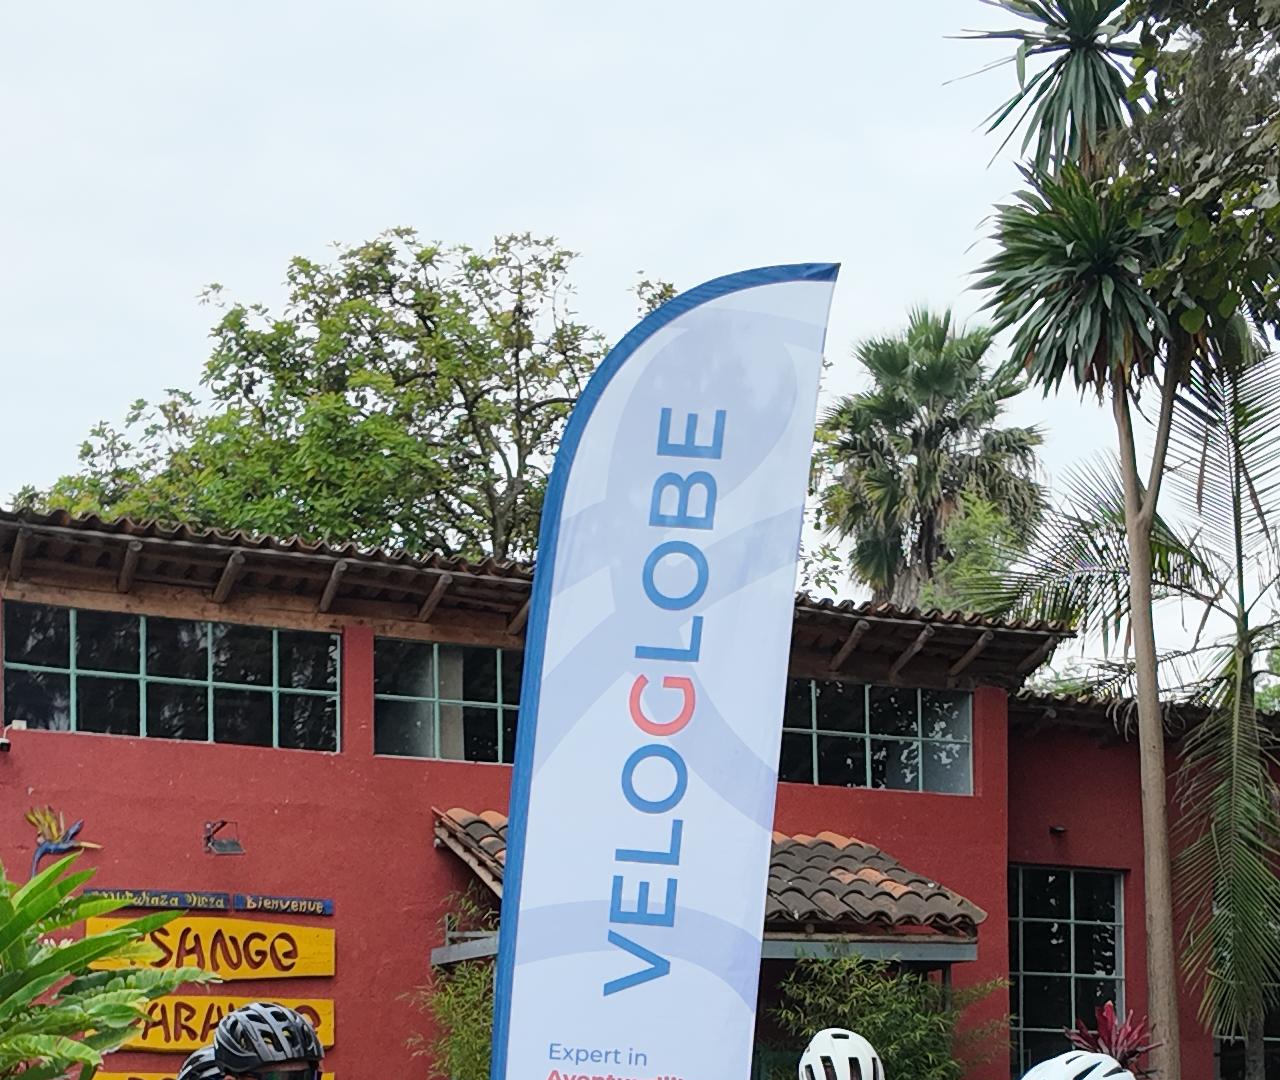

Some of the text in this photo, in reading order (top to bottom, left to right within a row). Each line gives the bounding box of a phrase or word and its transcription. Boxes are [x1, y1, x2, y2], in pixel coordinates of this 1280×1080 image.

[603, 407, 727, 997] VELOGLOBE
[246, 895, 324, 914] Bienvenue
[548, 1043, 648, 1067] Expert in
